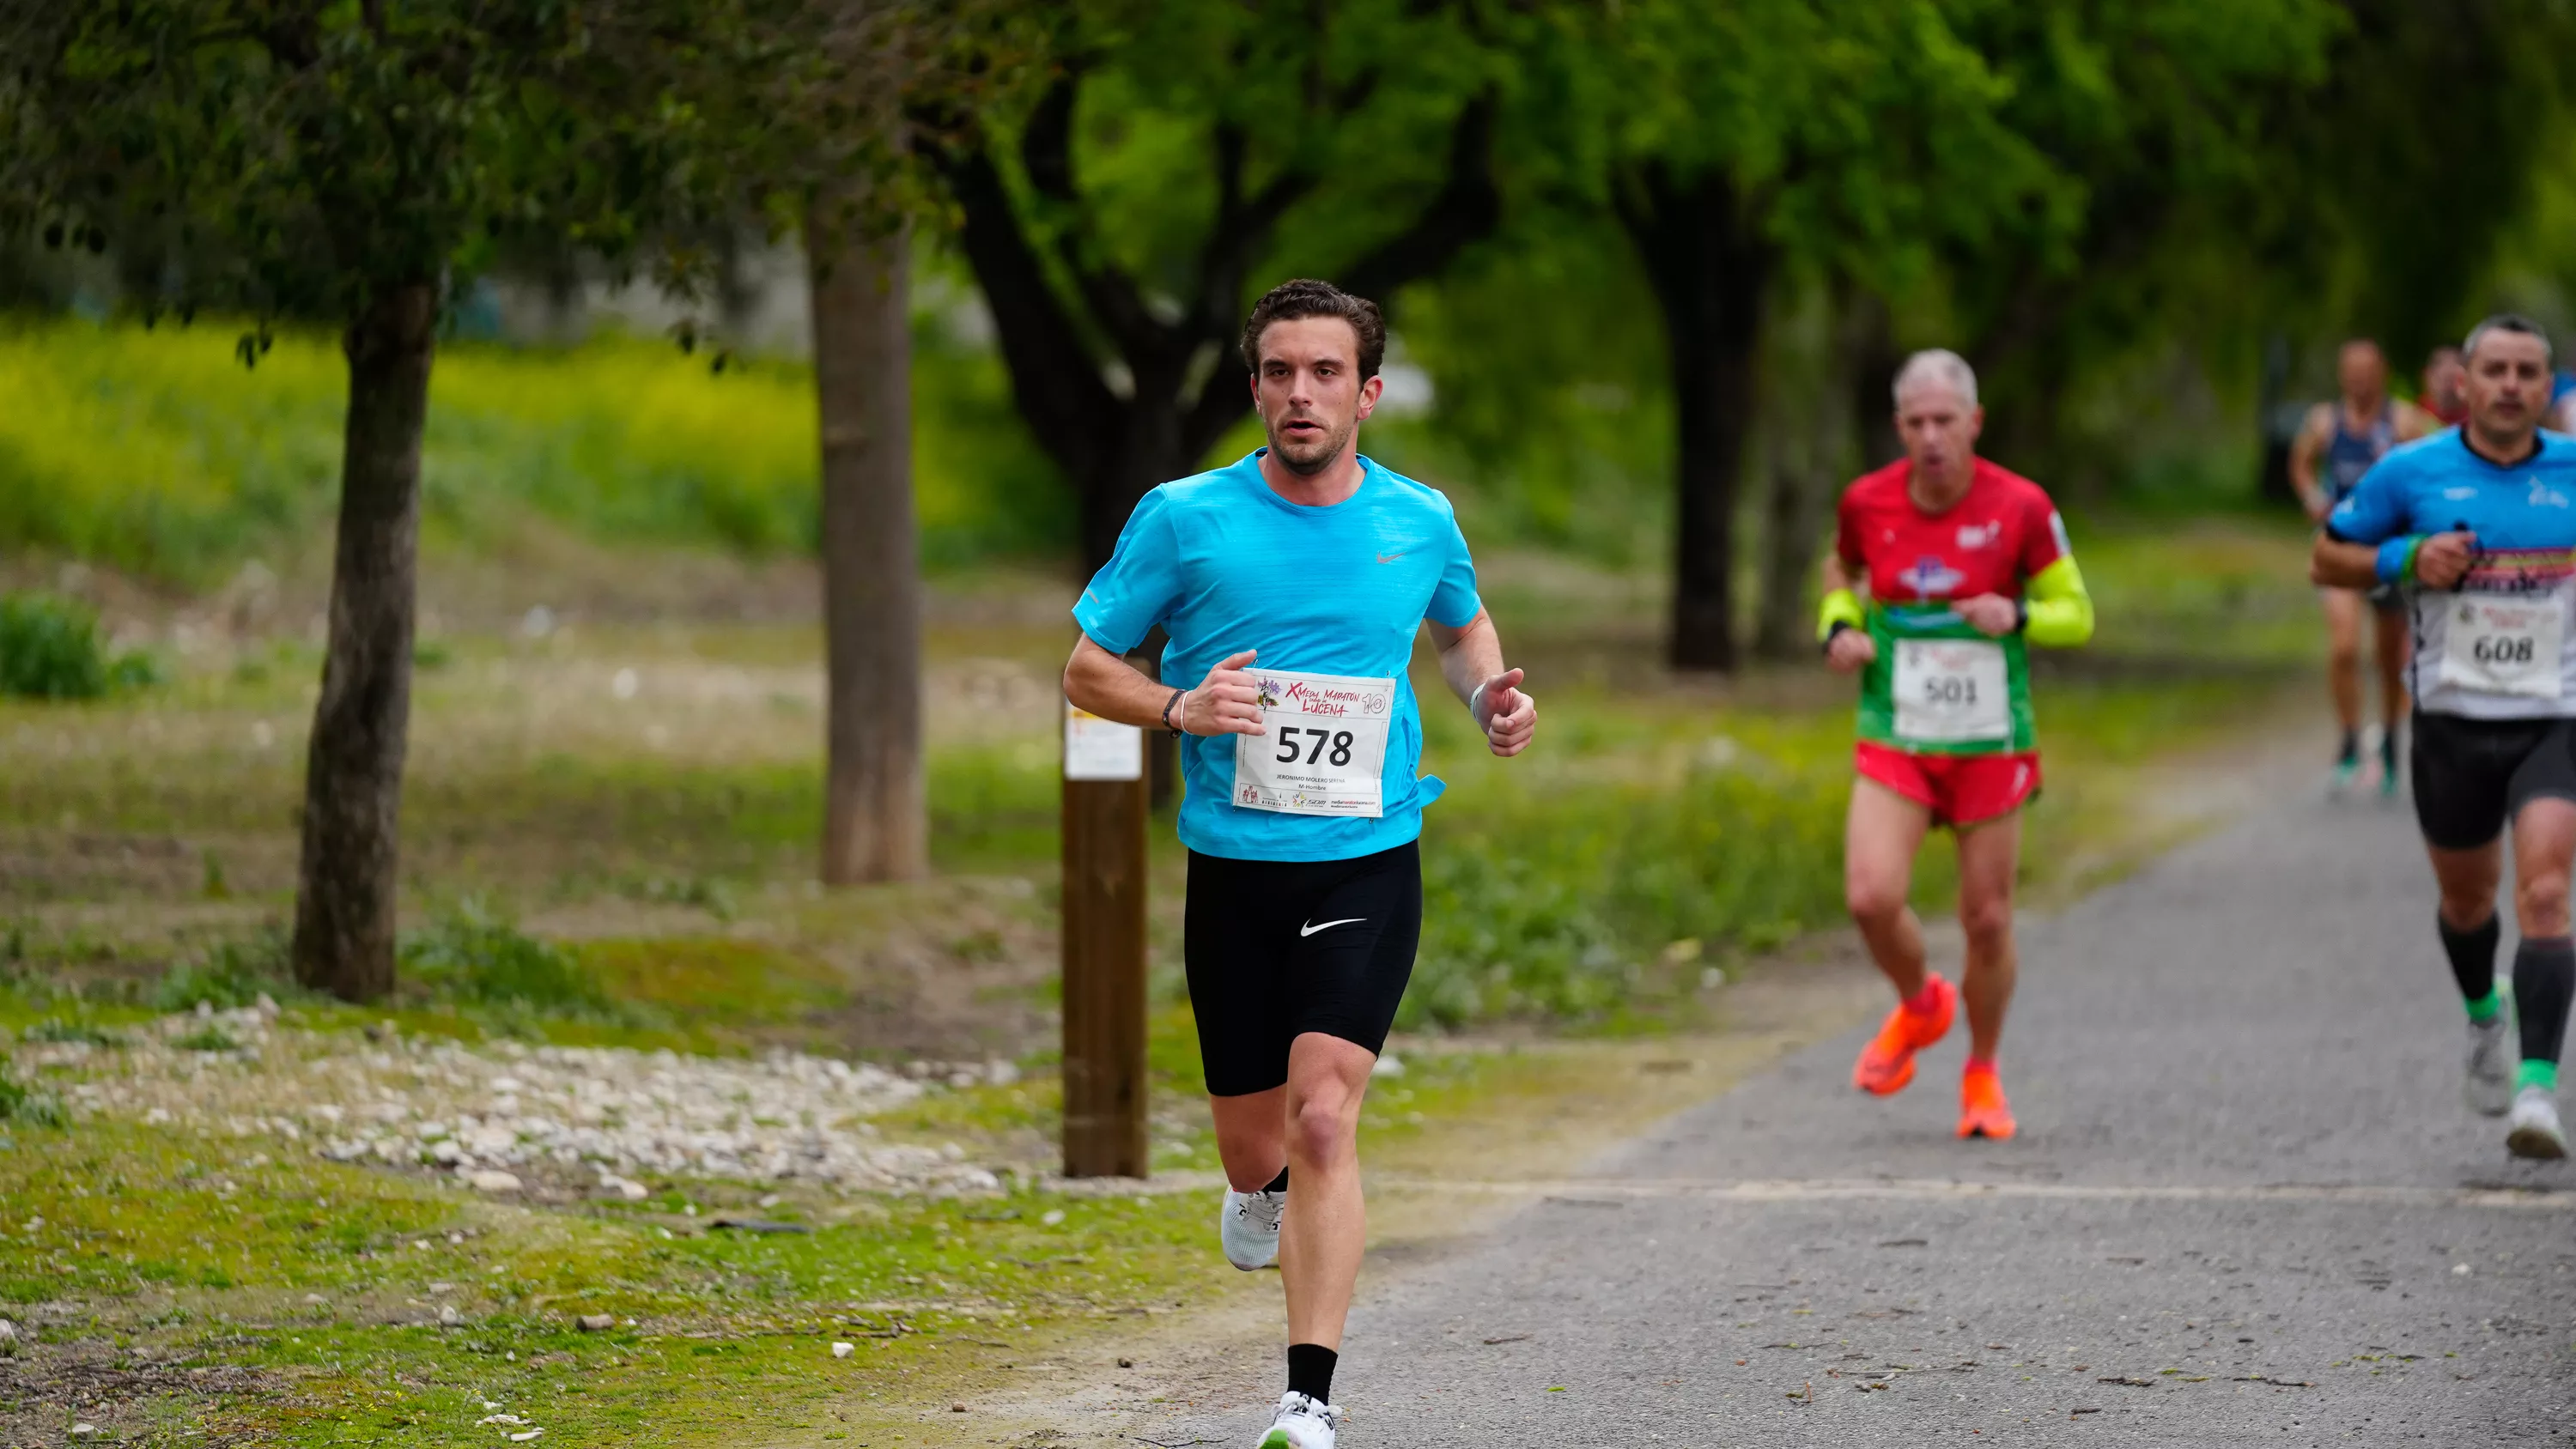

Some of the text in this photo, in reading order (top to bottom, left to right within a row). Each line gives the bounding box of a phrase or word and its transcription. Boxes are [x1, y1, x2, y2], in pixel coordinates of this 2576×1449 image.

[2474, 635, 2533, 662] 608
[1925, 676, 1977, 705] 501
[1303, 699, 1349, 717] LUCENA
[1276, 726, 1353, 767] 578
